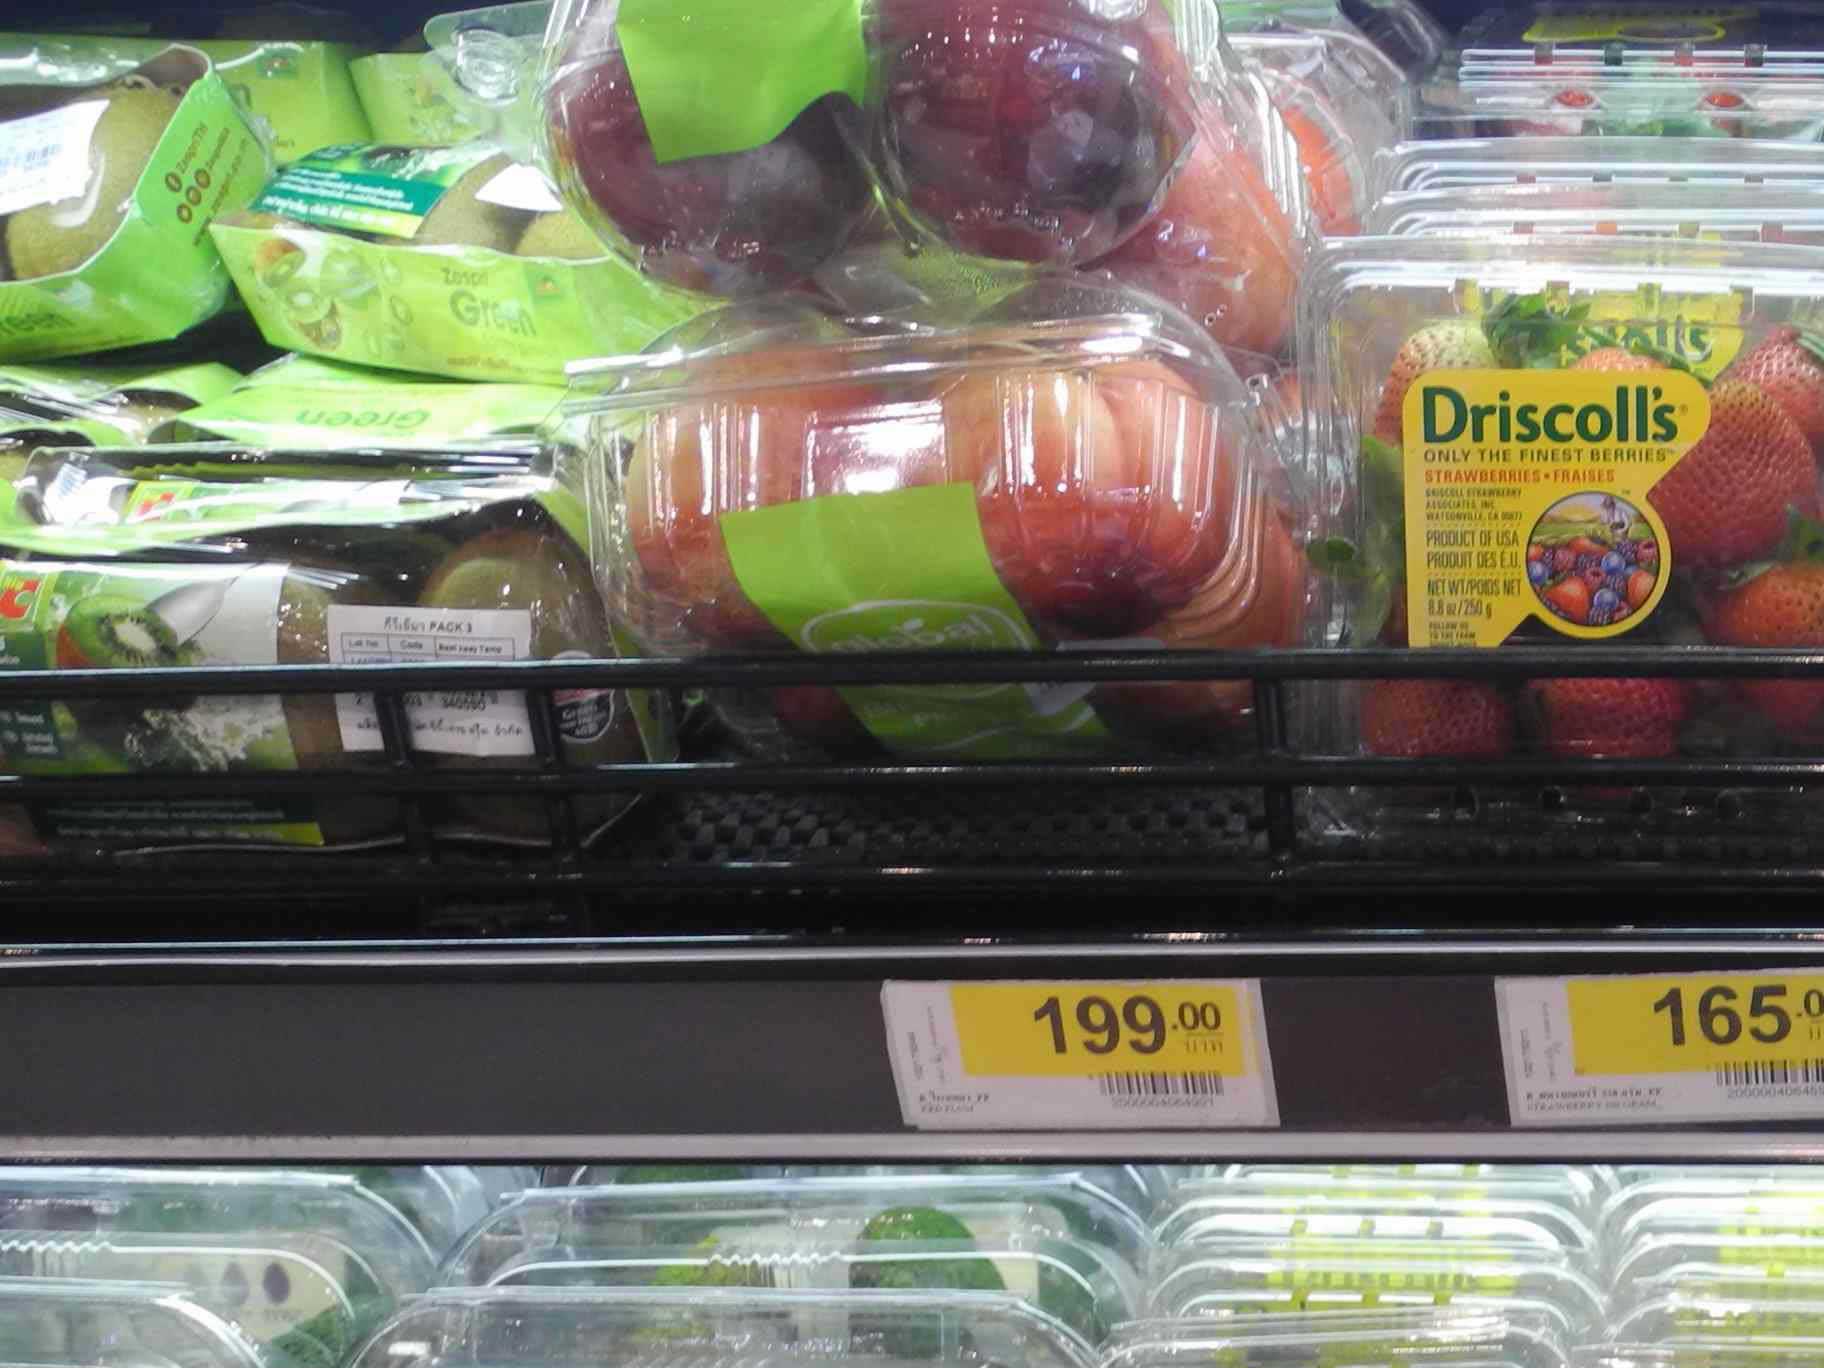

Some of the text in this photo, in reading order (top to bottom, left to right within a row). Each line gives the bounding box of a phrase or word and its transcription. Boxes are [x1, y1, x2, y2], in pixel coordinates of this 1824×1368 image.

[1422, 386, 1678, 444] Driscoll's
[1424, 448, 1666, 463] ONLY THE FINEST BERRIES
[1425, 469, 1615, 483] STRAWBERRIES FRAISES
[1426, 530, 1519, 548] PRODUCT OF USA
